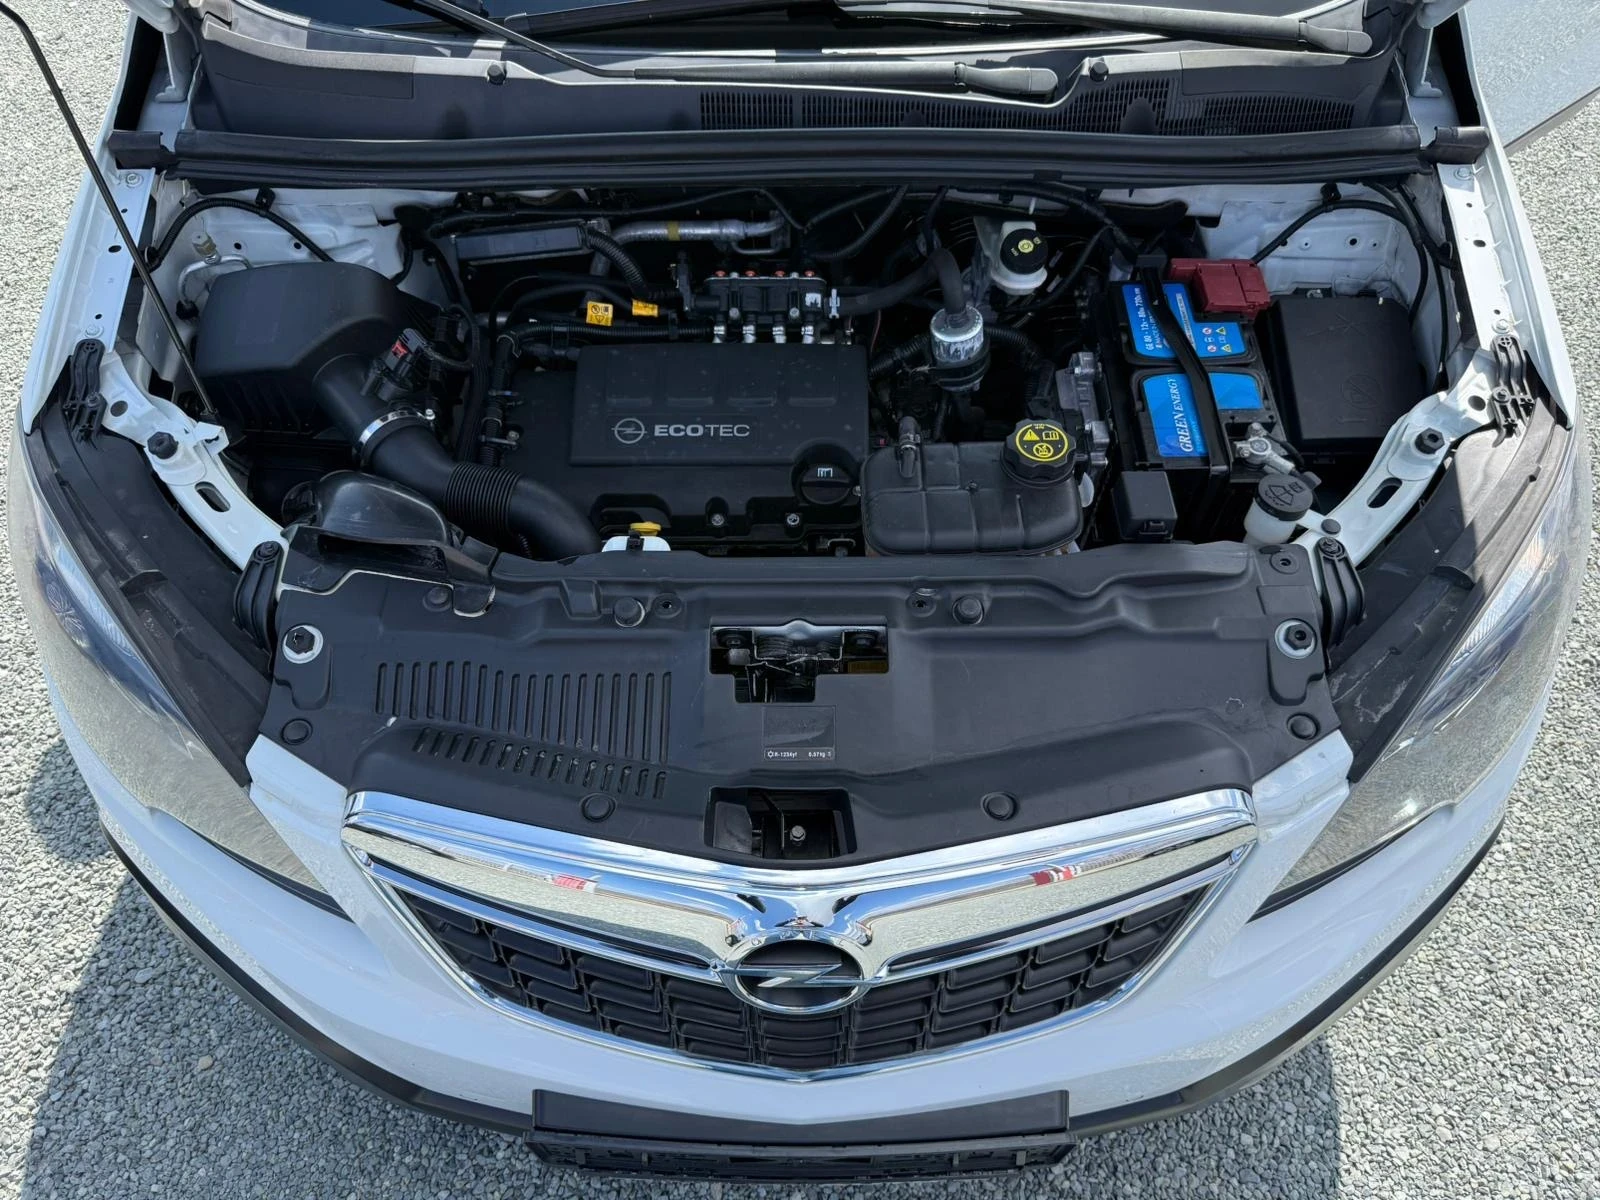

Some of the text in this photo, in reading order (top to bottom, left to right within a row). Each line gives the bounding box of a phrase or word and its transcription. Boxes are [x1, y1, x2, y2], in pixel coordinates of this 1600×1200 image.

[653, 424, 751, 437] ECOTEC
[1167, 378, 1194, 452] GREEN ENERGY
